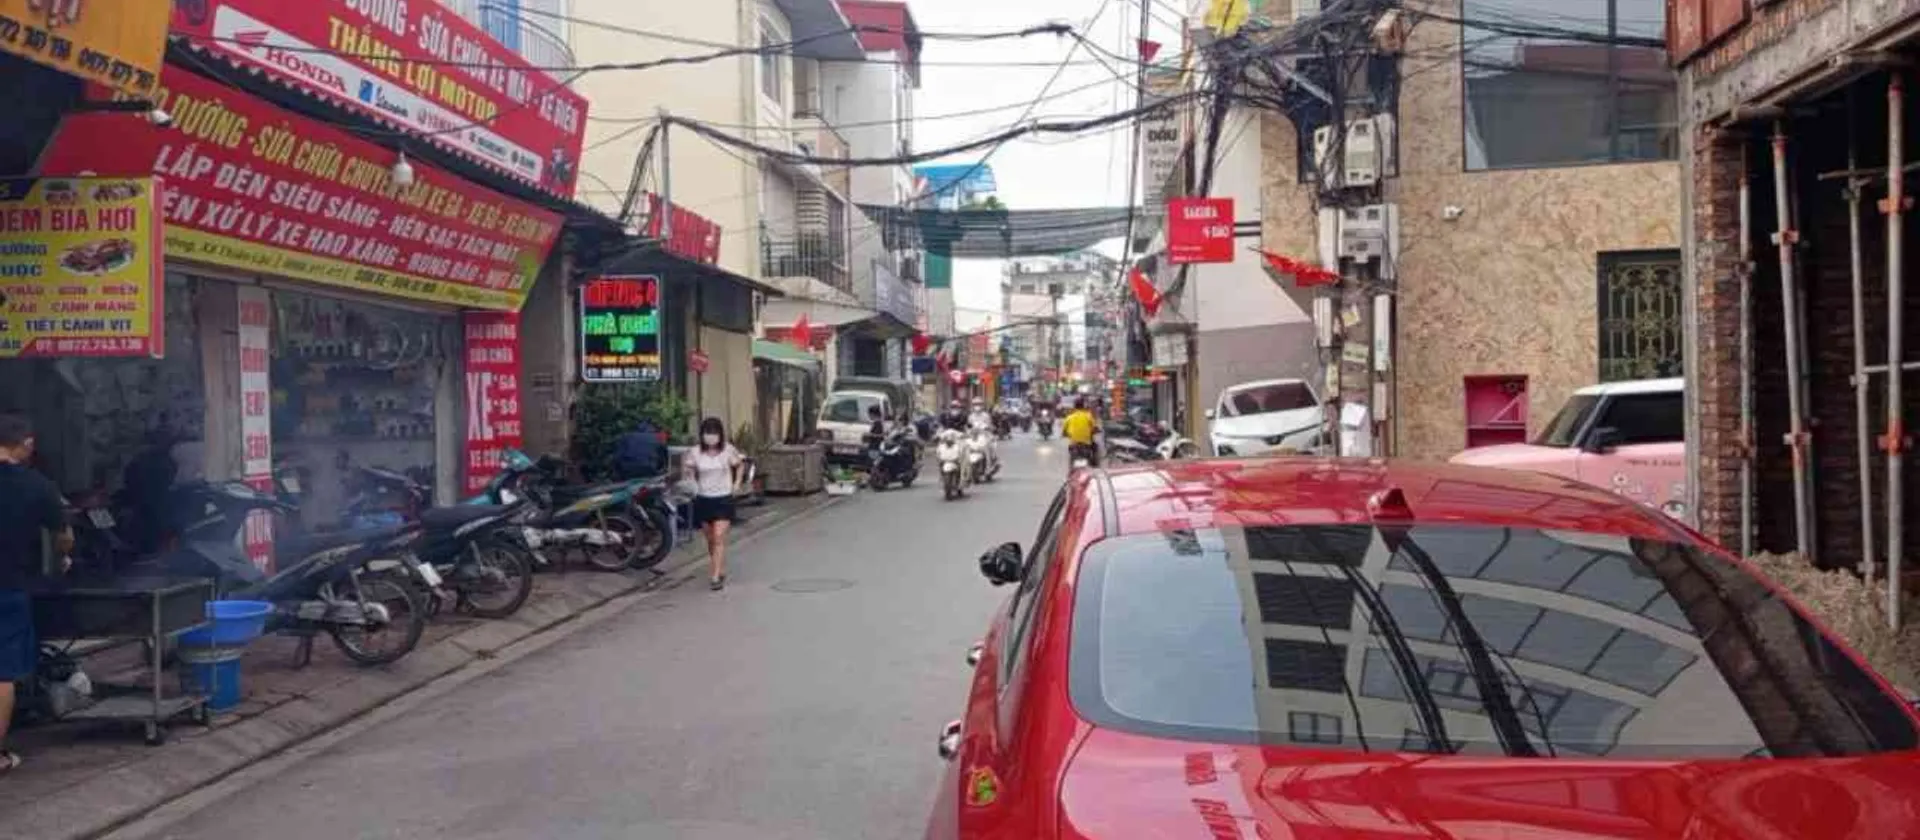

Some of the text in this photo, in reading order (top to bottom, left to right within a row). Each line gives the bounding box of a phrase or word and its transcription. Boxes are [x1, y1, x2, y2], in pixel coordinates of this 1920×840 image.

[265, 48, 347, 94] HONDA
[152, 141, 214, 182] LẮP
[213, 164, 271, 199] ĐÈN
[268, 178, 326, 215] SIÊU
[323, 196, 382, 231] SÁNG
[51, 207, 89, 231] BIA
[239, 211, 273, 239] LÝ
[270, 218, 306, 247] XE
[303, 227, 350, 255] HAO
[466, 372, 494, 440] XE
